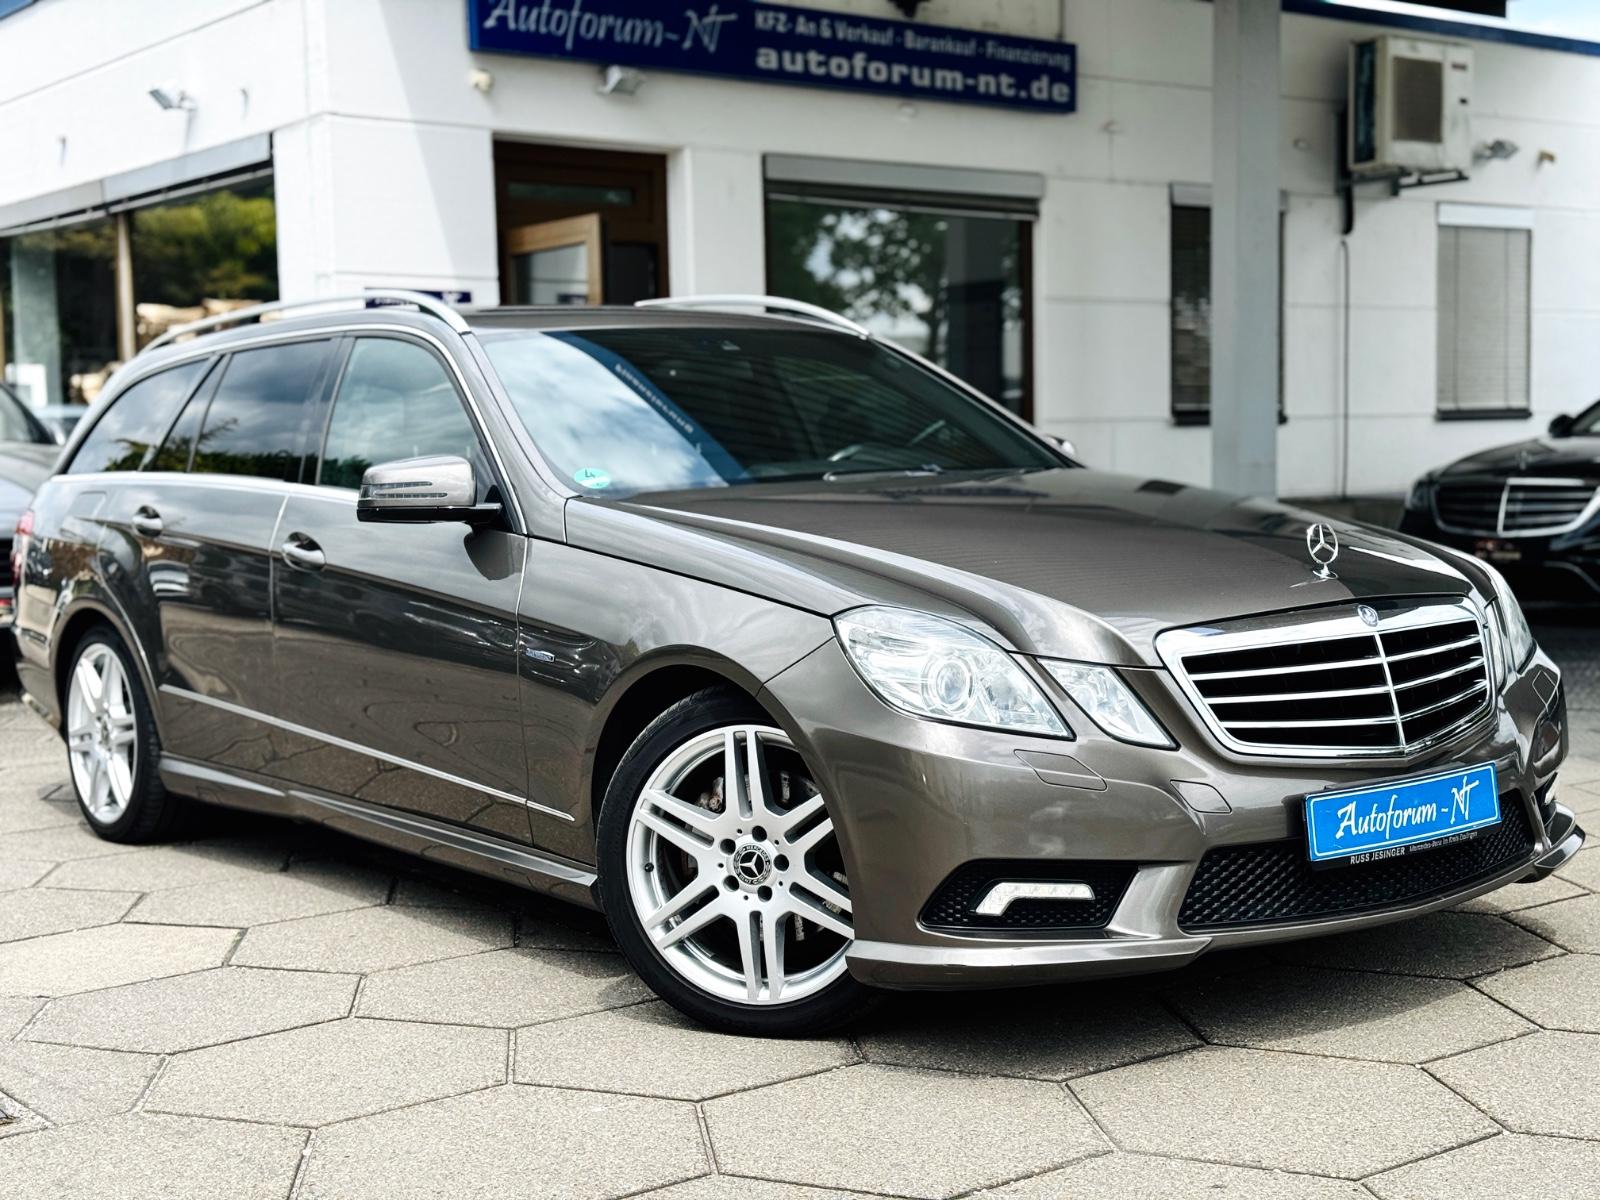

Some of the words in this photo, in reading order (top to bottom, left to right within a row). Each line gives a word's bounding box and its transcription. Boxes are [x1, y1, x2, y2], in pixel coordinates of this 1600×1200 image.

[819, 18, 833, 38] &
[834, 20, 895, 46] Verkauf
[904, 29, 977, 57] Barankauf
[985, 40, 1071, 72] Finanzierung
[755, 48, 1071, 103] autoforum-nt.de
[1350, 853, 1370, 865] RUSS
[1371, 847, 1406, 861] JESINGER
